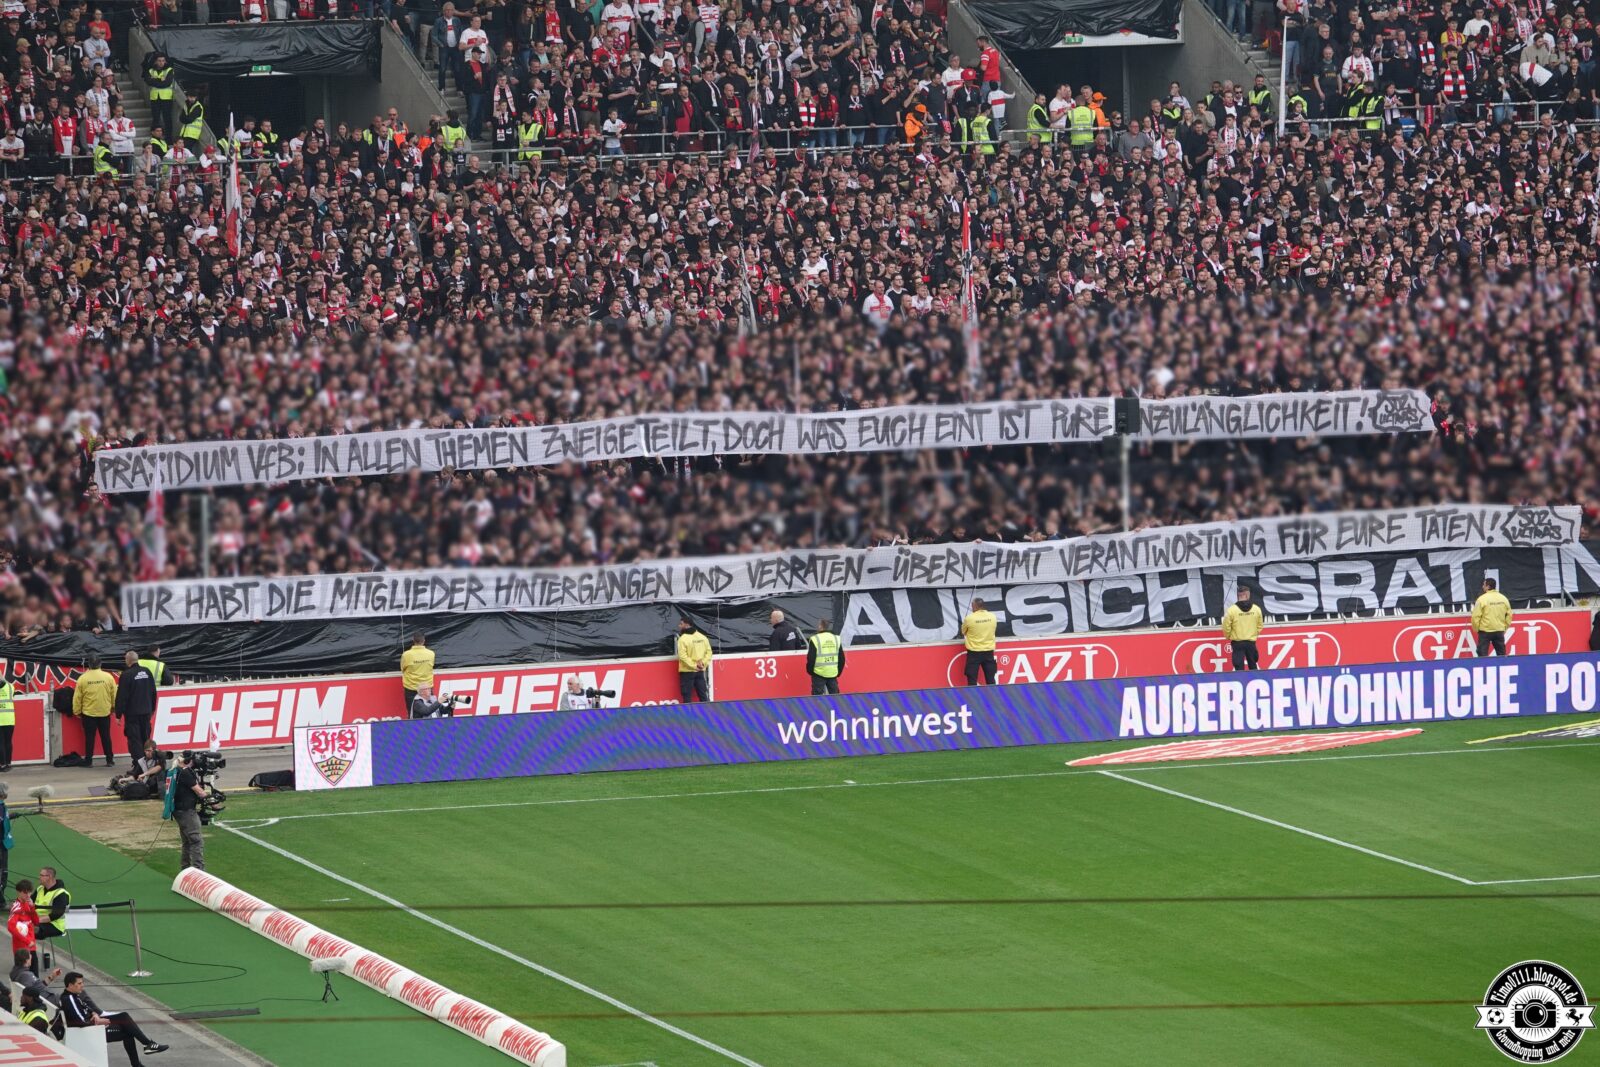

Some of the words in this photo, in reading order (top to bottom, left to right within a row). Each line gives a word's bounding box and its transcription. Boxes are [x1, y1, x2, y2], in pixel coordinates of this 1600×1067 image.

[314, 438, 339, 474] IN
[348, 437, 421, 473] ALLEN
[424, 431, 528, 469] THEMEN
[722, 416, 785, 451] DOCH
[797, 417, 847, 450] WAS
[858, 411, 928, 447] EUCH
[935, 408, 992, 443] EINT
[998, 403, 1043, 441] IST
[1050, 401, 1113, 439] PURE
[1140, 396, 1369, 437] NZULÄNGLICHKEIT!
[126, 585, 175, 623] IHR
[185, 581, 260, 620] HABT
[266, 579, 316, 616] DIE
[330, 573, 487, 614] MITGLIEDER
[495, 565, 674, 606] HINTERGANGEN
[685, 565, 733, 594] UND
[746, 553, 866, 589] VERRATEN
[893, 546, 1054, 584] ÜBERNEHMT
[1059, 524, 1267, 577] VERANTWORTUNG
[1277, 519, 1329, 555] FÜR
[1336, 513, 1407, 550] EURE
[1415, 508, 1501, 544] TATEN!
[840, 547, 1481, 648] AUFSICHTSRAT
[755, 658, 777, 678] 33
[1545, 661, 1600, 713] PO
[152, 686, 347, 745] EHEIM
[310, 729, 357, 754] VfB
[777, 704, 973, 745] wohninvest
